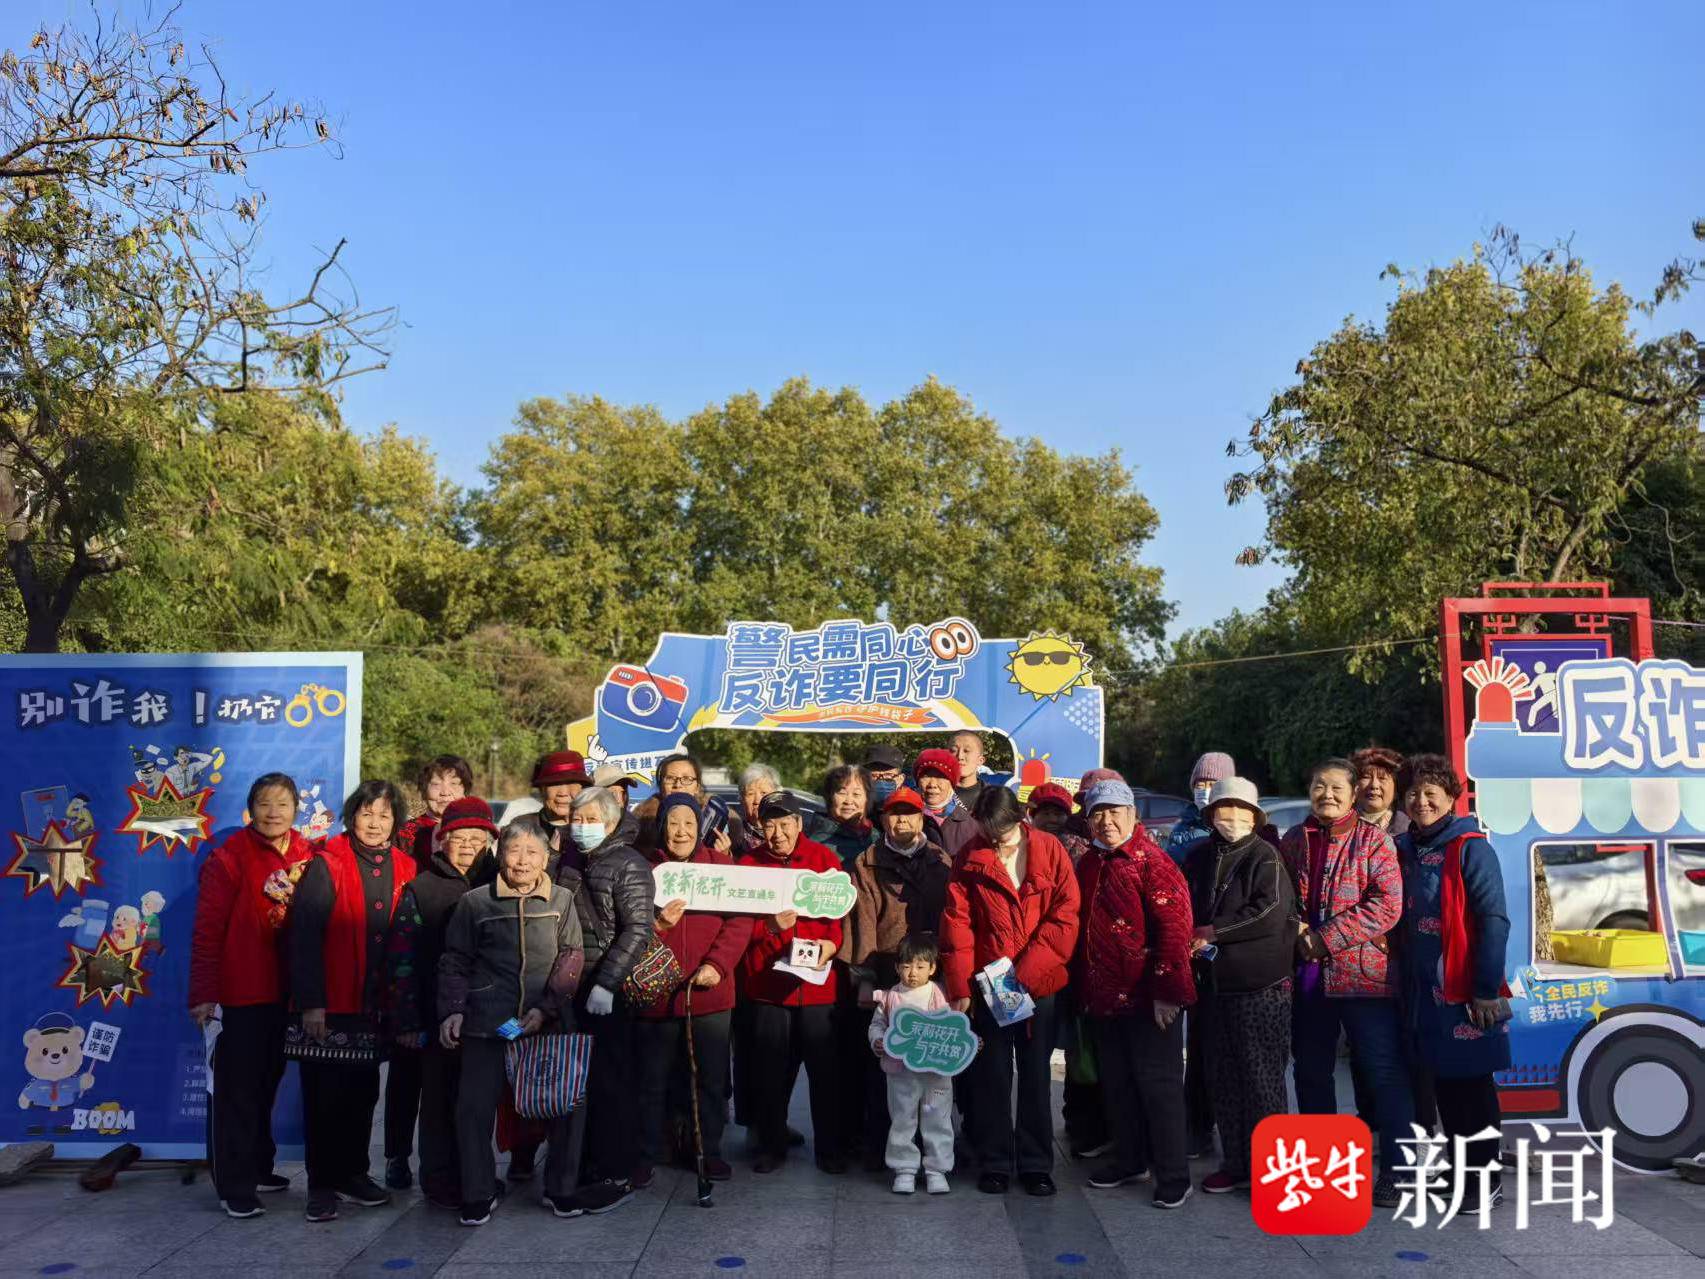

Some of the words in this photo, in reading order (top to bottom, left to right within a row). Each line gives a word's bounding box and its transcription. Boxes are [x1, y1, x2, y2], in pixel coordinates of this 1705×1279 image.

[730, 624, 931, 669] 警民需同心
[721, 659, 960, 712] 反诈要同行
[1572, 675, 1705, 760] 反诈
[1545, 980, 1608, 1001] 全民反诈
[1528, 1001, 1583, 1024] 我先行
[92, 1027, 116, 1043] 谨防
[88, 1040, 111, 1056] 诈骗
[71, 1109, 135, 1130] BOOM
